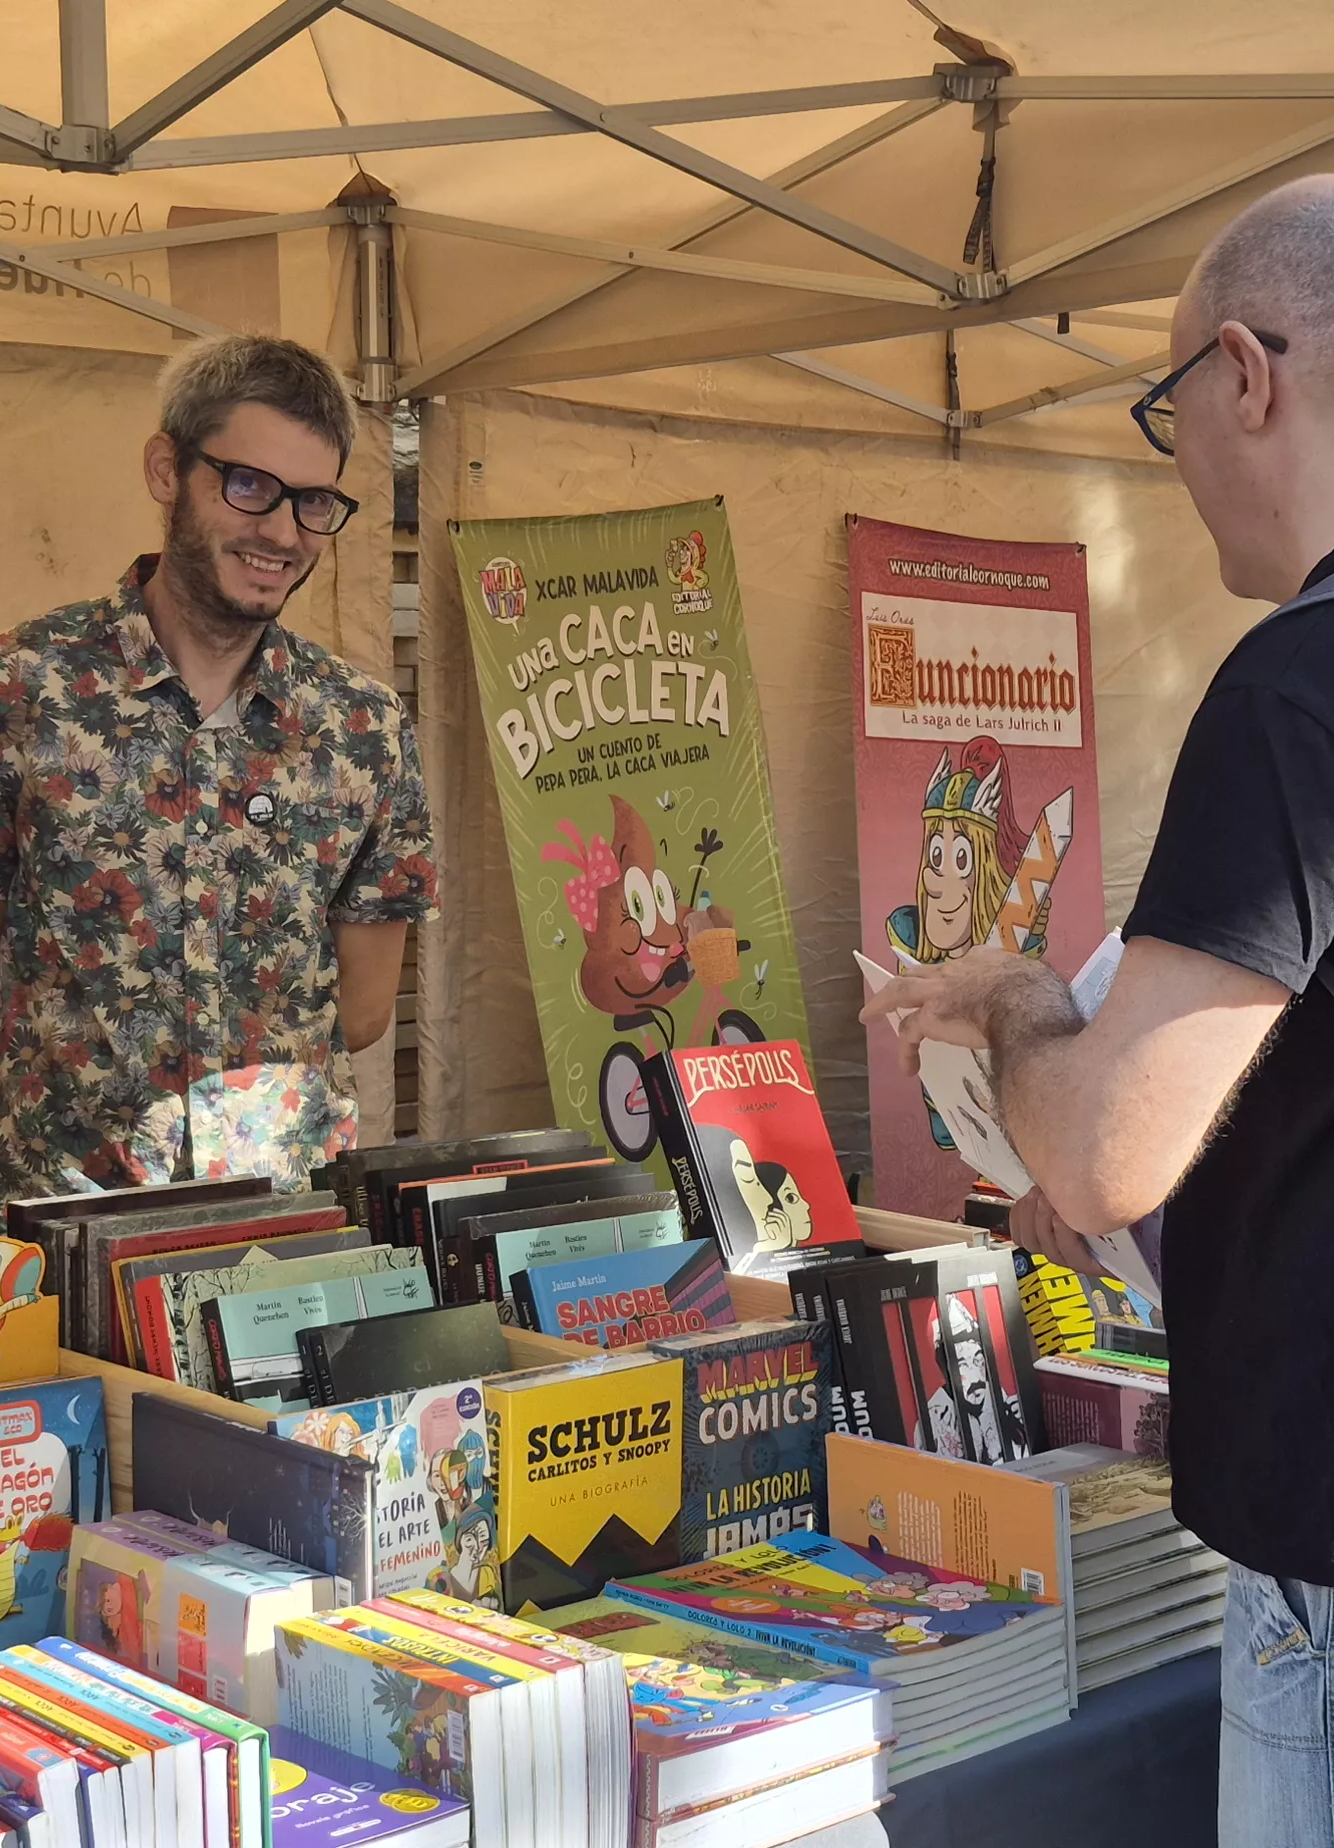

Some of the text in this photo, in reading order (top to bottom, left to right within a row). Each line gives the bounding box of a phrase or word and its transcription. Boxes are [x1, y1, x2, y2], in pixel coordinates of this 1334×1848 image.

[479, 566, 526, 594] MALA
[535, 566, 660, 600] XCAR MALAVIDA
[888, 558, 1051, 591] www.editorialcornoque.com
[559, 602, 664, 665] CACA
[496, 658, 730, 780] BICICLETA
[902, 710, 918, 725] La
[923, 715, 952, 730] saga
[956, 714, 971, 728] de
[976, 715, 1004, 730] Lars
[1008, 717, 1049, 731] Julrich
[578, 733, 662, 764] UN CUENTO DE
[535, 775, 566, 794] PEPA
[607, 762, 621, 779] LA
[625, 756, 657, 776] CACA
[662, 744, 710, 769] VIAJERA
[683, 1050, 815, 1108] PERSÉPOLIS
[672, 1156, 704, 1225] PERSÉPOLIS
[552, 1278, 577, 1292] Jaime
[557, 1285, 670, 1329] SANGRE
[605, 1308, 707, 1350] BARRIO
[698, 1342, 820, 1401] MARVEL
[699, 1384, 817, 1445] COMICS
[528, 1401, 672, 1465] SCHULZ
[0, 1449, 25, 1468] EL
[528, 1439, 671, 1483] CARLITOS Y SNOOPY
[10, 1491, 53, 1515] ORO
[550, 1493, 576, 1507] UNA
[706, 1468, 812, 1521] LA HISTORIA
[399, 1519, 430, 1545] ARTE
[715, 1573, 736, 1585] LA
[688, 1610, 746, 1635] DOLORES Y LOLO
[382, 1635, 462, 1665] INTRUSOS
